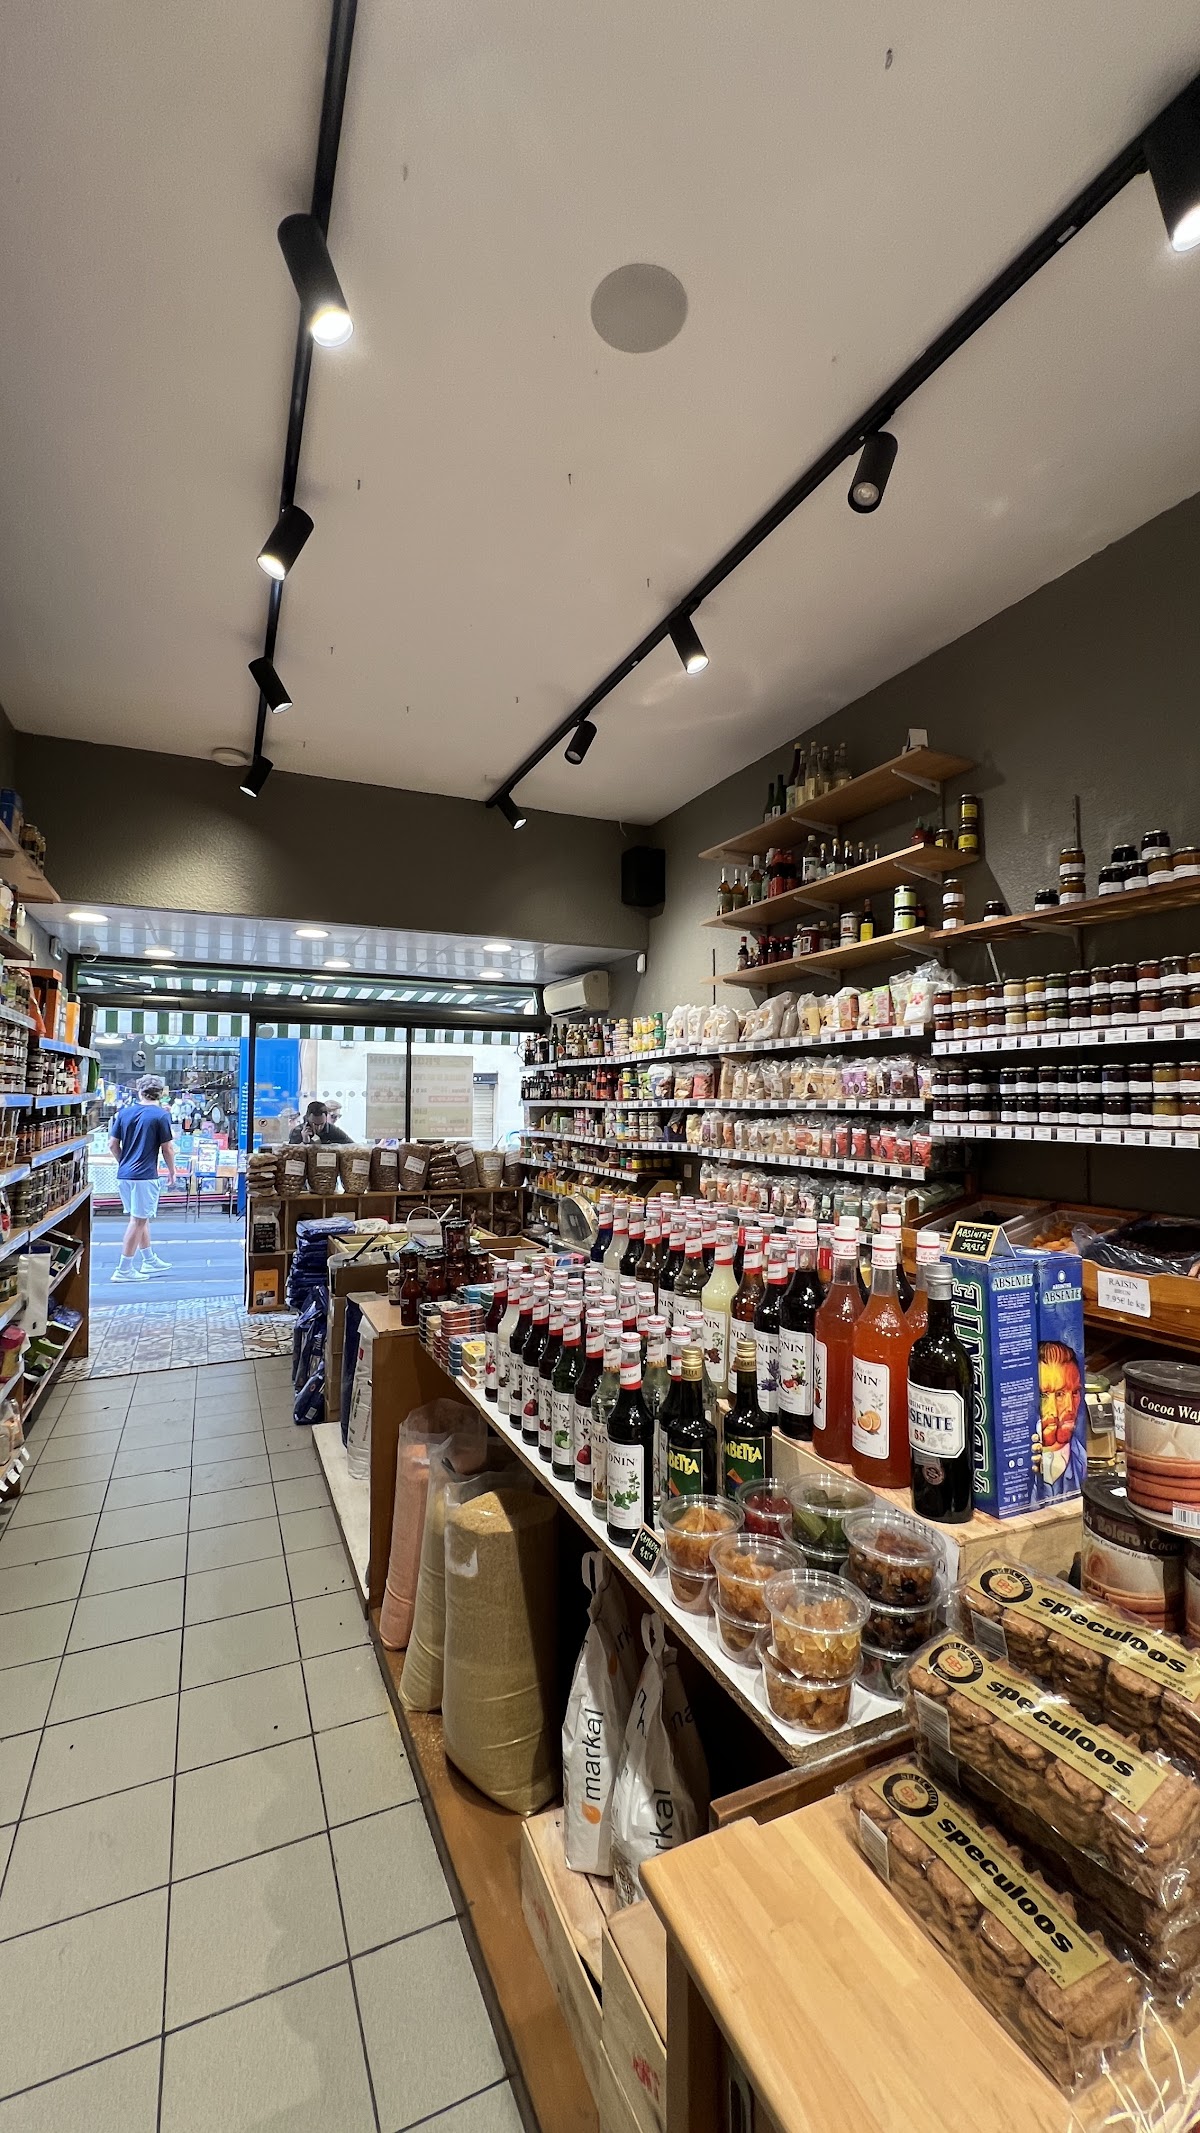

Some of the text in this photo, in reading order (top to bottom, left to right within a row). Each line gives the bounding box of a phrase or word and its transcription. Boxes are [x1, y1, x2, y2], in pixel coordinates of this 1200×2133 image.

[993, 1275, 1033, 1290] ABSENTE
[1108, 1277, 1138, 1290] RAISIN
[1044, 1289, 1082, 1303] ABSENTE
[1127, 1298, 1134, 1306] le
[1136, 1300, 1146, 1310] kg
[756, 1343, 778, 1354] NIN
[1140, 1396, 1175, 1416] Cocoa
[909, 1407, 954, 1431] SENTE
[913, 1429, 926, 1442] 55
[668, 1453, 700, 1475] BETTA
[1096, 1515, 1142, 1546] Bolero
[1038, 1595, 1188, 1674] speculoos
[942, 1642, 984, 1675] SELECTION
[985, 1680, 1136, 1778] speculoos
[583, 1708, 605, 1801] markal
[900, 1772, 939, 1808] SELECTION
[649, 1789, 674, 1850] rkal
[936, 1817, 1074, 1954] speculoos
